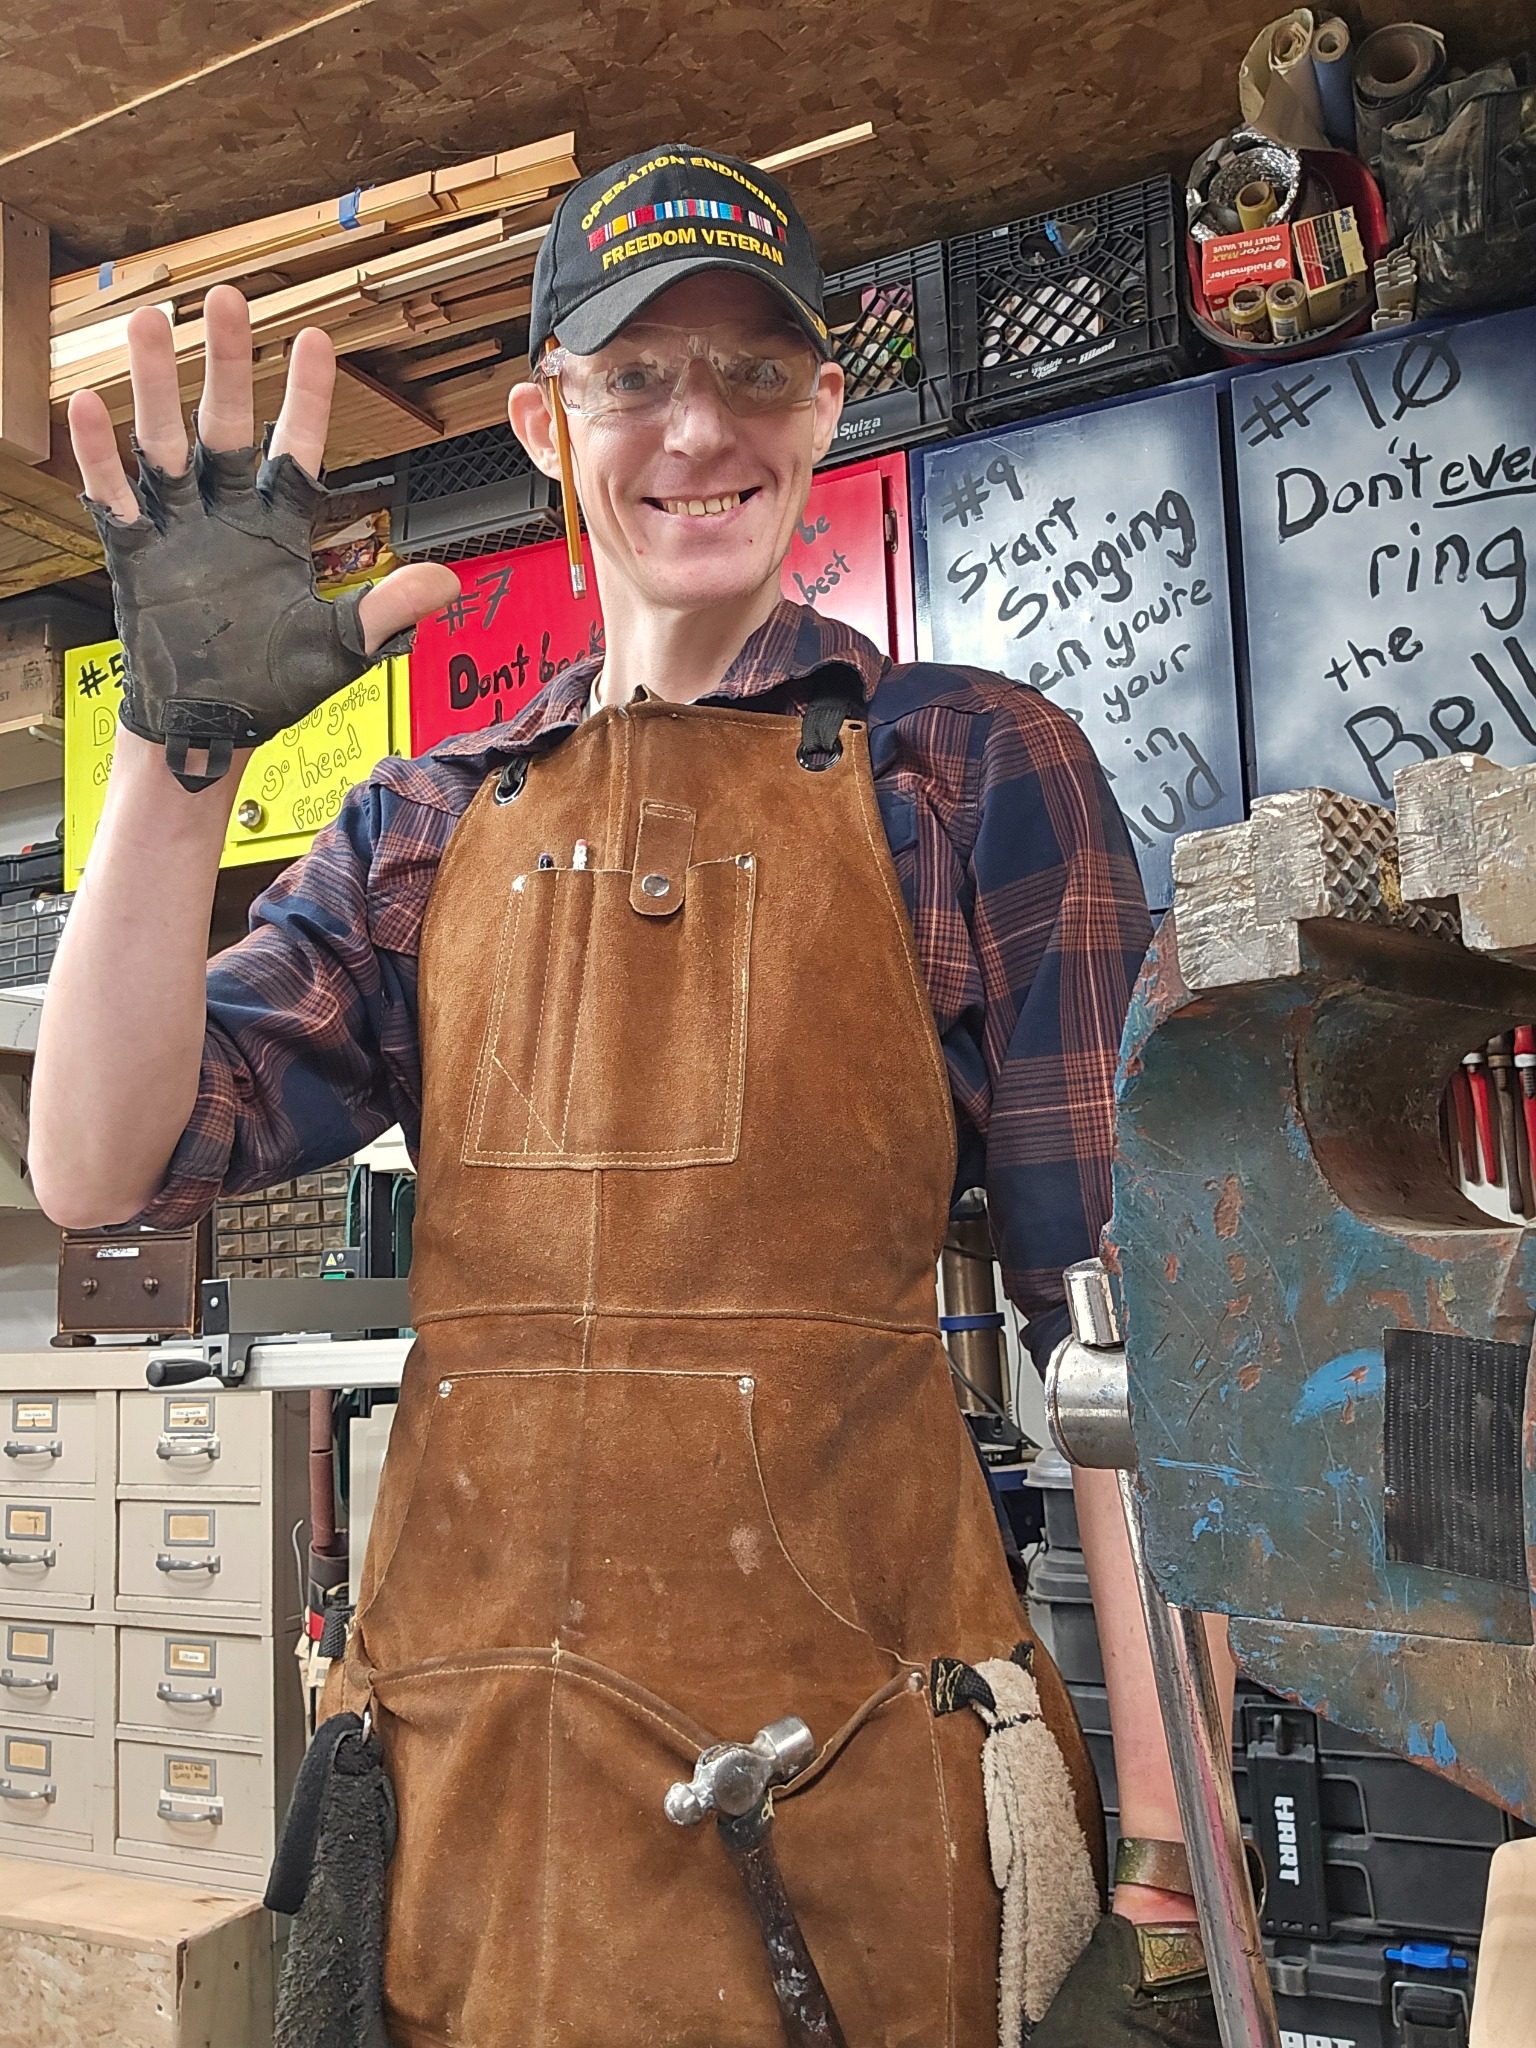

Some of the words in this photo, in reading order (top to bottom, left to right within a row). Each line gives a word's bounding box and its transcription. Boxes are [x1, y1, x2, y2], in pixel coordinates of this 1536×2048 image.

[580, 154, 685, 231] OPERATION
[691, 156, 789, 227] ENDURING
[602, 227, 697, 271] FREEDOM
[700, 228, 785, 267] VETERAN
[1208, 260, 1273, 280] Fluidmaster
[1212, 242, 1237, 253] VALVE
[1237, 238, 1254, 248] FILL
[1254, 234, 1281, 245] TOILET
[1078, 338, 1117, 365] Hiland
[839, 417, 881, 437] Suiza
[942, 455, 1024, 528] #9
[1440, 443, 1536, 497] eve
[792, 550, 851, 605] best
[947, 496, 1077, 604] Start
[998, 489, 1197, 640] Singing
[1369, 522, 1526, 630] ring
[436, 566, 514, 636] #7
[449, 643, 531, 710] Dont
[1103, 644, 1191, 724] your
[1324, 627, 1423, 691] the
[327, 682, 380, 735] gotta
[261, 760, 290, 801] go
[297, 723, 362, 788] head
[1273, 1795, 1300, 1886] HART
